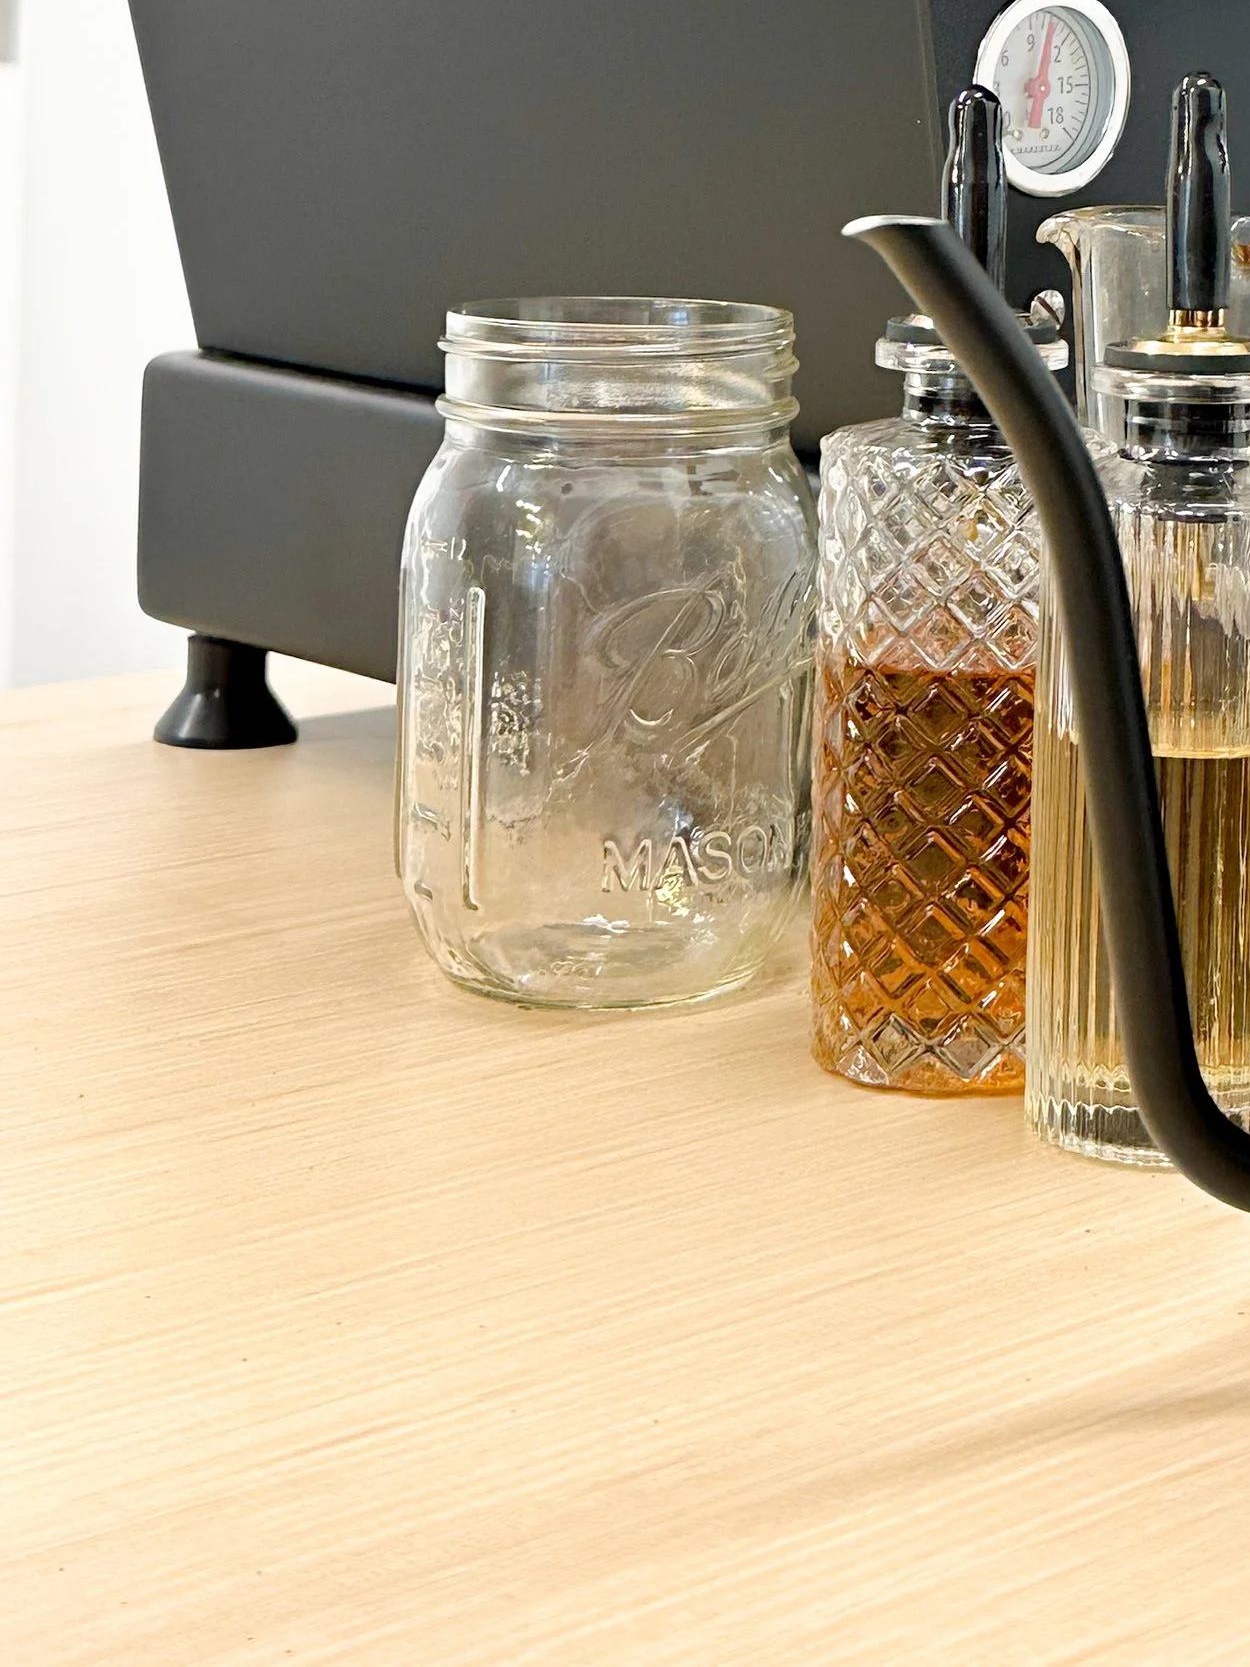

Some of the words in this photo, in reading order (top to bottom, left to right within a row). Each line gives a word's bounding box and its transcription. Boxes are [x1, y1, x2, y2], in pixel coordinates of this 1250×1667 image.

[1027, 34, 1036, 53] 9
[1000, 49, 1010, 68] 6
[1058, 76, 1074, 95] 15
[1048, 106, 1065, 125] 18
[600, 824, 796, 892] MASON
